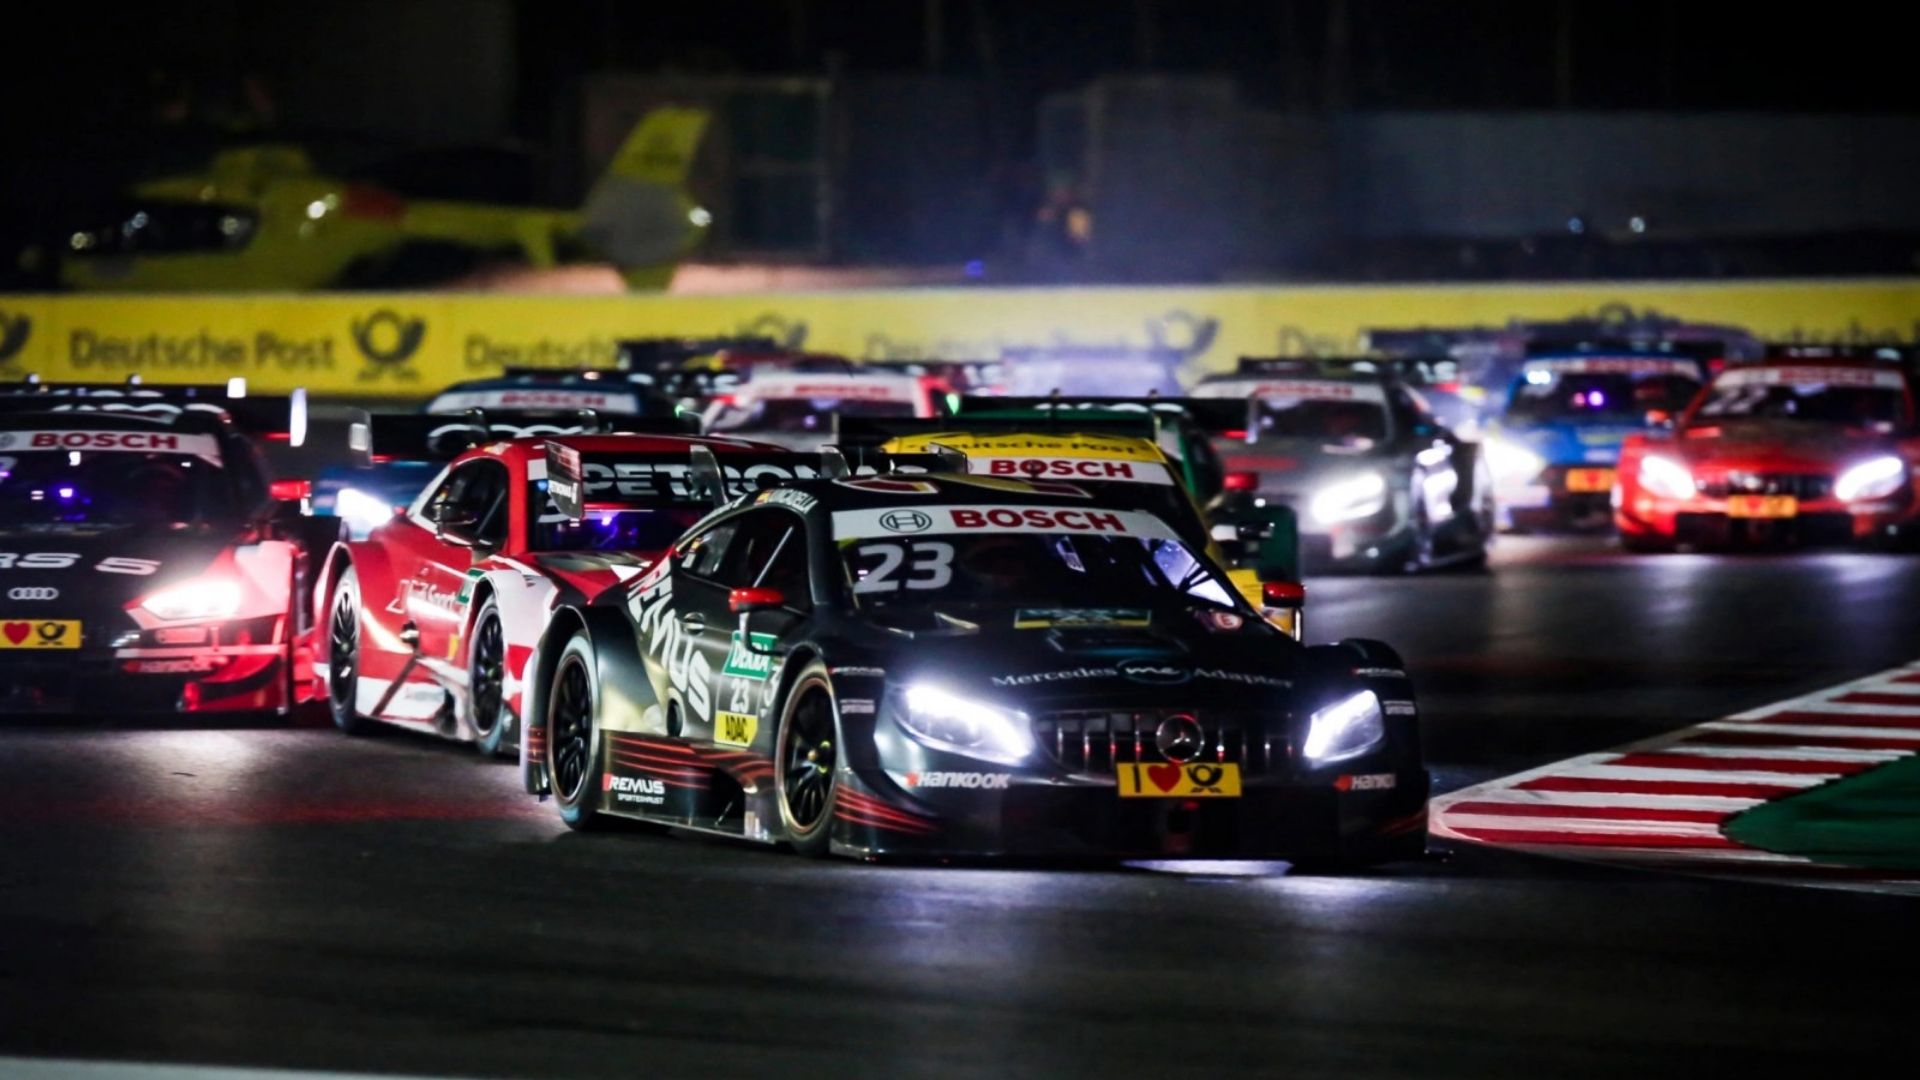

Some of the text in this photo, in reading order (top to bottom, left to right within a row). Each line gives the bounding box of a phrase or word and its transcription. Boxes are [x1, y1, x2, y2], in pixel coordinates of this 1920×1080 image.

[70, 327, 332, 369] Deutsche Post
[464, 333, 617, 370] Deutsch
[31, 433, 178, 449] BOSCH
[989, 460, 1134, 479] BOSCH
[948, 508, 1127, 532] BOSCH
[95, 557, 161, 575] 5
[852, 541, 955, 594] 23
[991, 667, 1118, 687] Mercedes
[1193, 668, 1294, 689] Adapter
[730, 679, 751, 714] 23
[725, 715, 749, 743] ADAC
[608, 775, 666, 795] REMUS
